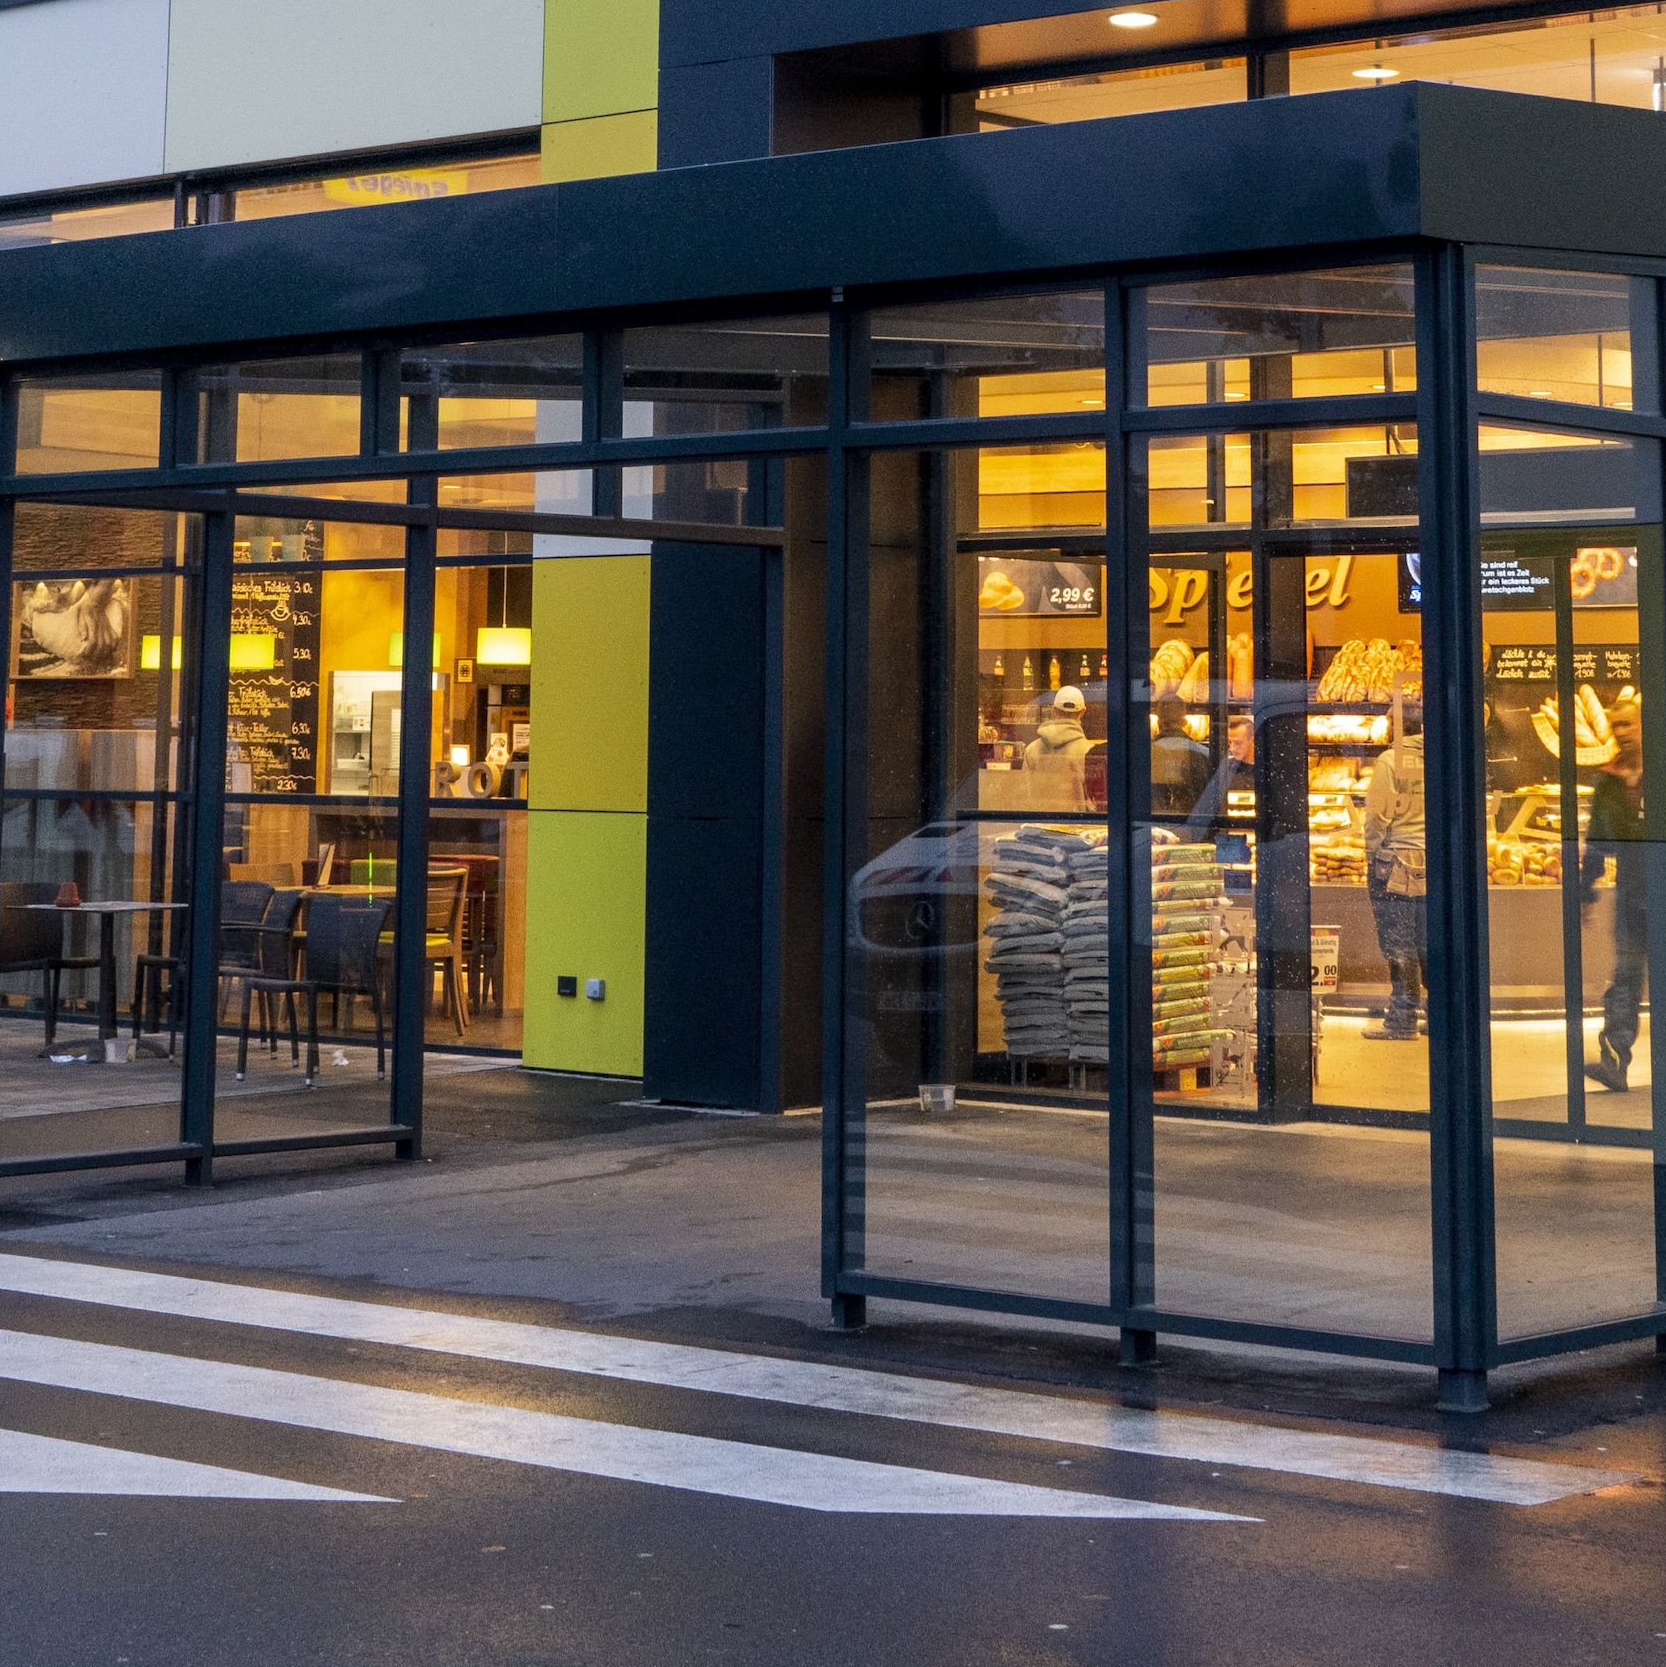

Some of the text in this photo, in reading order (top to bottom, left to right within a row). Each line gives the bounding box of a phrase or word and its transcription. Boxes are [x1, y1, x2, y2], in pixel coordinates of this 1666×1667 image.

[1489, 561, 1506, 569] sind
[1506, 560, 1518, 568] reif
[1496, 569, 1506, 577] ist
[1516, 568, 1530, 577] Zeit
[1501, 577, 1530, 585] leckeres
[1530, 576, 1550, 585] Stück
[1481, 585, 1535, 595] wetschgenblotz
[1050, 587, 1095, 604] 2,99 €
